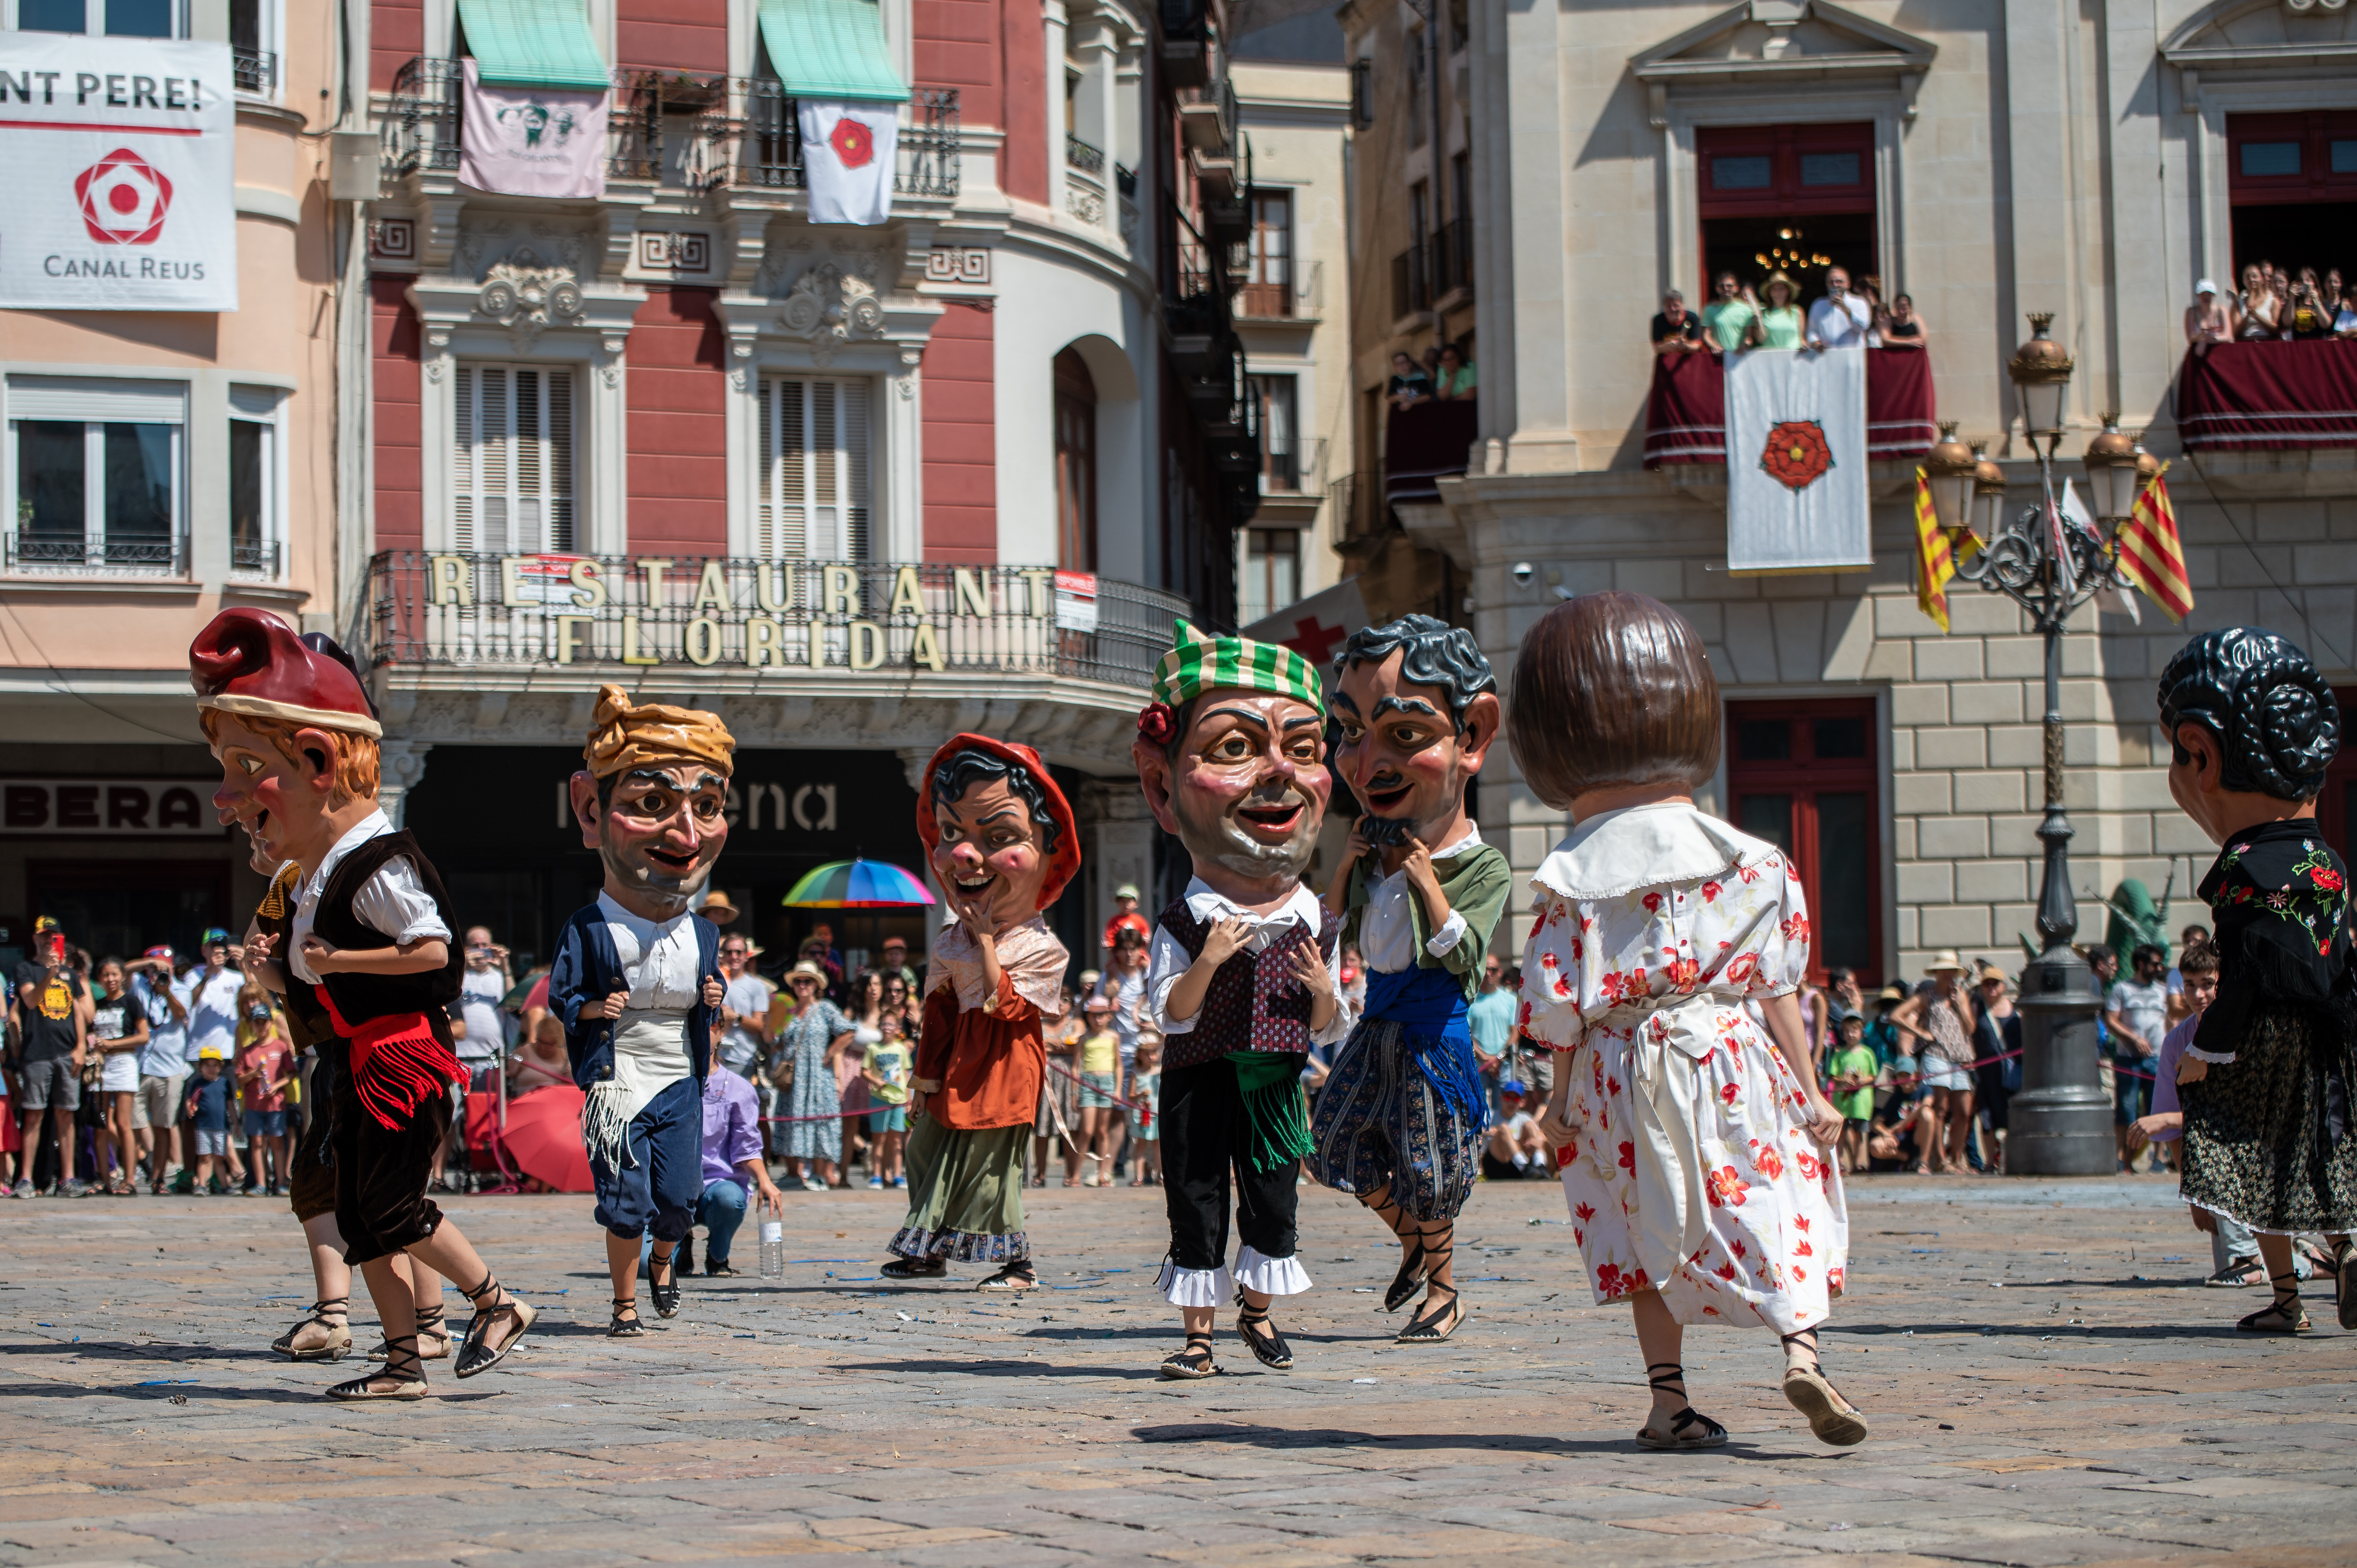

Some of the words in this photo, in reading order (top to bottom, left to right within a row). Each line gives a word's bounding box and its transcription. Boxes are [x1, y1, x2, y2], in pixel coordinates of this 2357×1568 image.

[76, 73, 201, 113] PERE!
[432, 556, 1053, 619] RESTAURANT
[557, 615, 945, 672] FLORIDA
